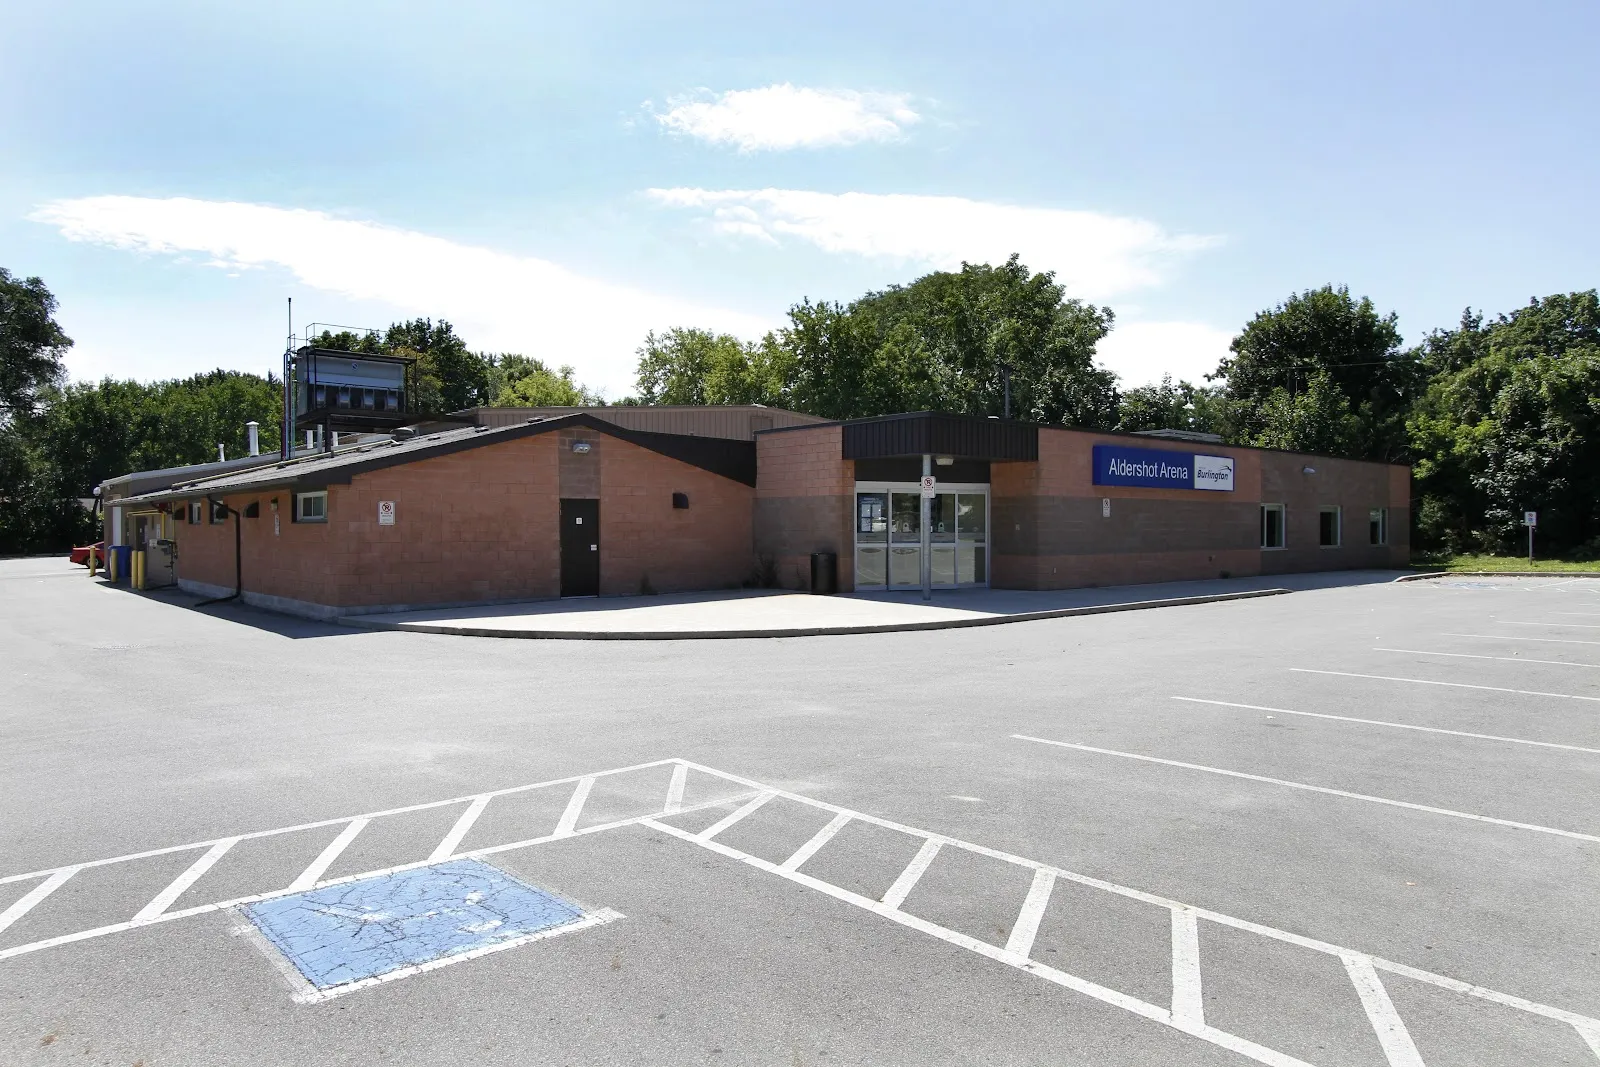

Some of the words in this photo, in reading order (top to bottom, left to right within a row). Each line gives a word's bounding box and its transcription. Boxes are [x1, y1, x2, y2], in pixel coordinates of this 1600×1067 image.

[1109, 458, 1158, 478] Aldershot
[1160, 462, 1188, 479] Arena
[1197, 470, 1229, 482] Burlington
